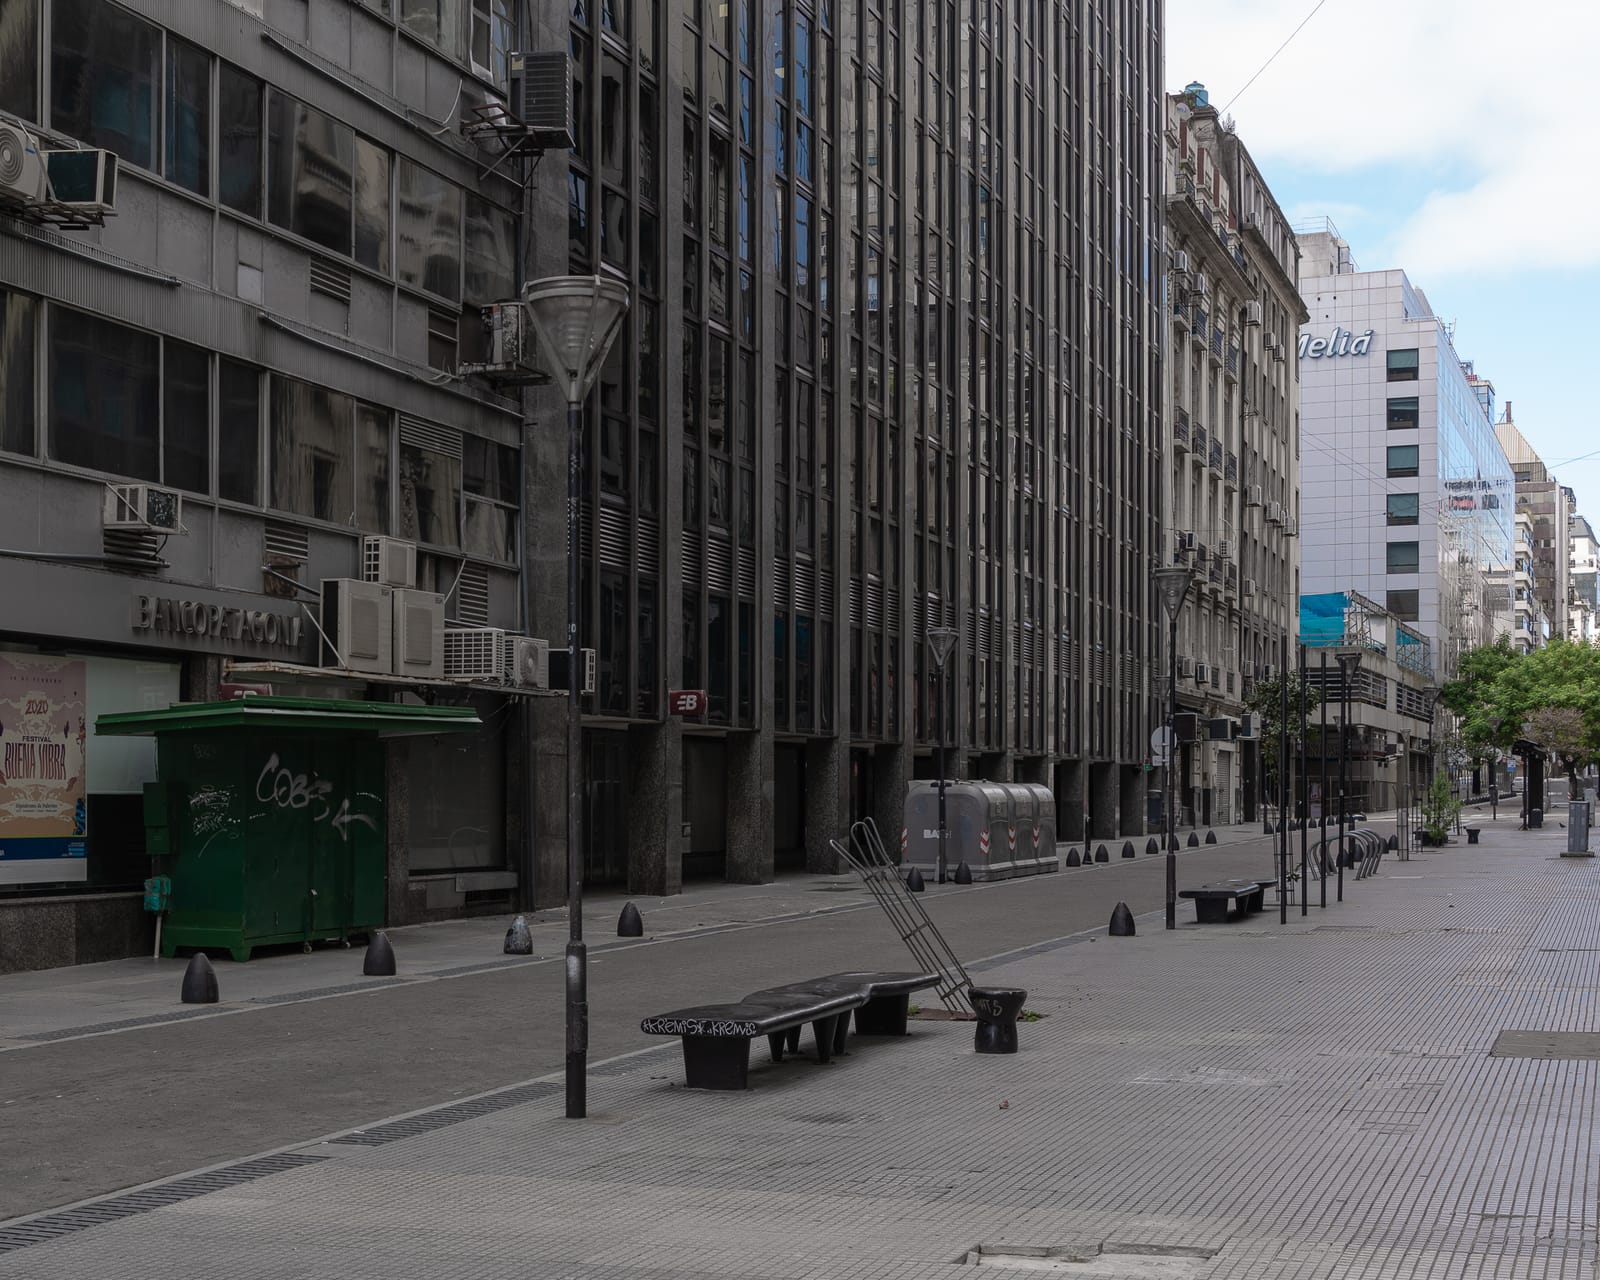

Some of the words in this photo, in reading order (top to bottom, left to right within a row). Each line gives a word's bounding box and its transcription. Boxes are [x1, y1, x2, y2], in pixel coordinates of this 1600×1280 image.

[25, 699, 49, 715] 2020
[22, 735, 52, 743] FESTIVAL
[5, 742, 36, 780] BUENA
[39, 743, 67, 780] VIBRA
